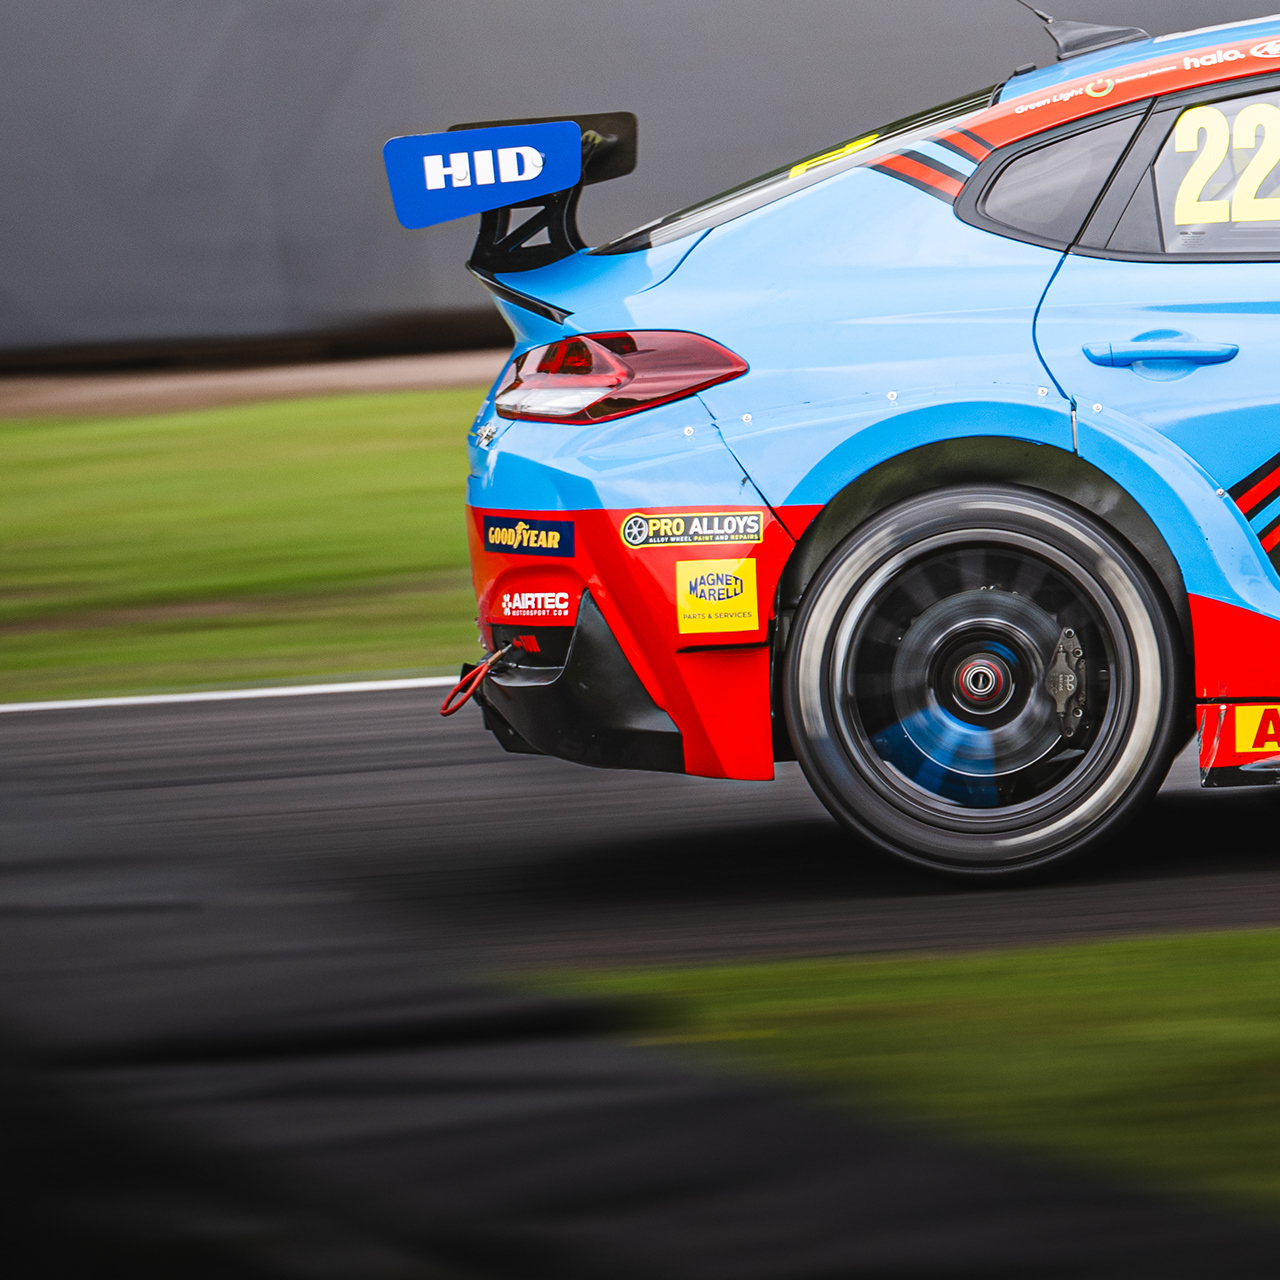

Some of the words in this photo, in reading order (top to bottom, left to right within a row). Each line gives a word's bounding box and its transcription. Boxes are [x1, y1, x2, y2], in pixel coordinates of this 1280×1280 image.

[1014, 97, 1051, 115] Green
[1052, 87, 1085, 104] Light
[423, 145, 545, 191] HID
[648, 518, 685, 537] PRO
[689, 516, 759, 535] ALLOYS
[689, 573, 744, 590] MAGNETI
[512, 592, 569, 609] AIRTEC
[689, 582, 744, 602] MARELLI
[715, 611, 752, 619] SERVICES
